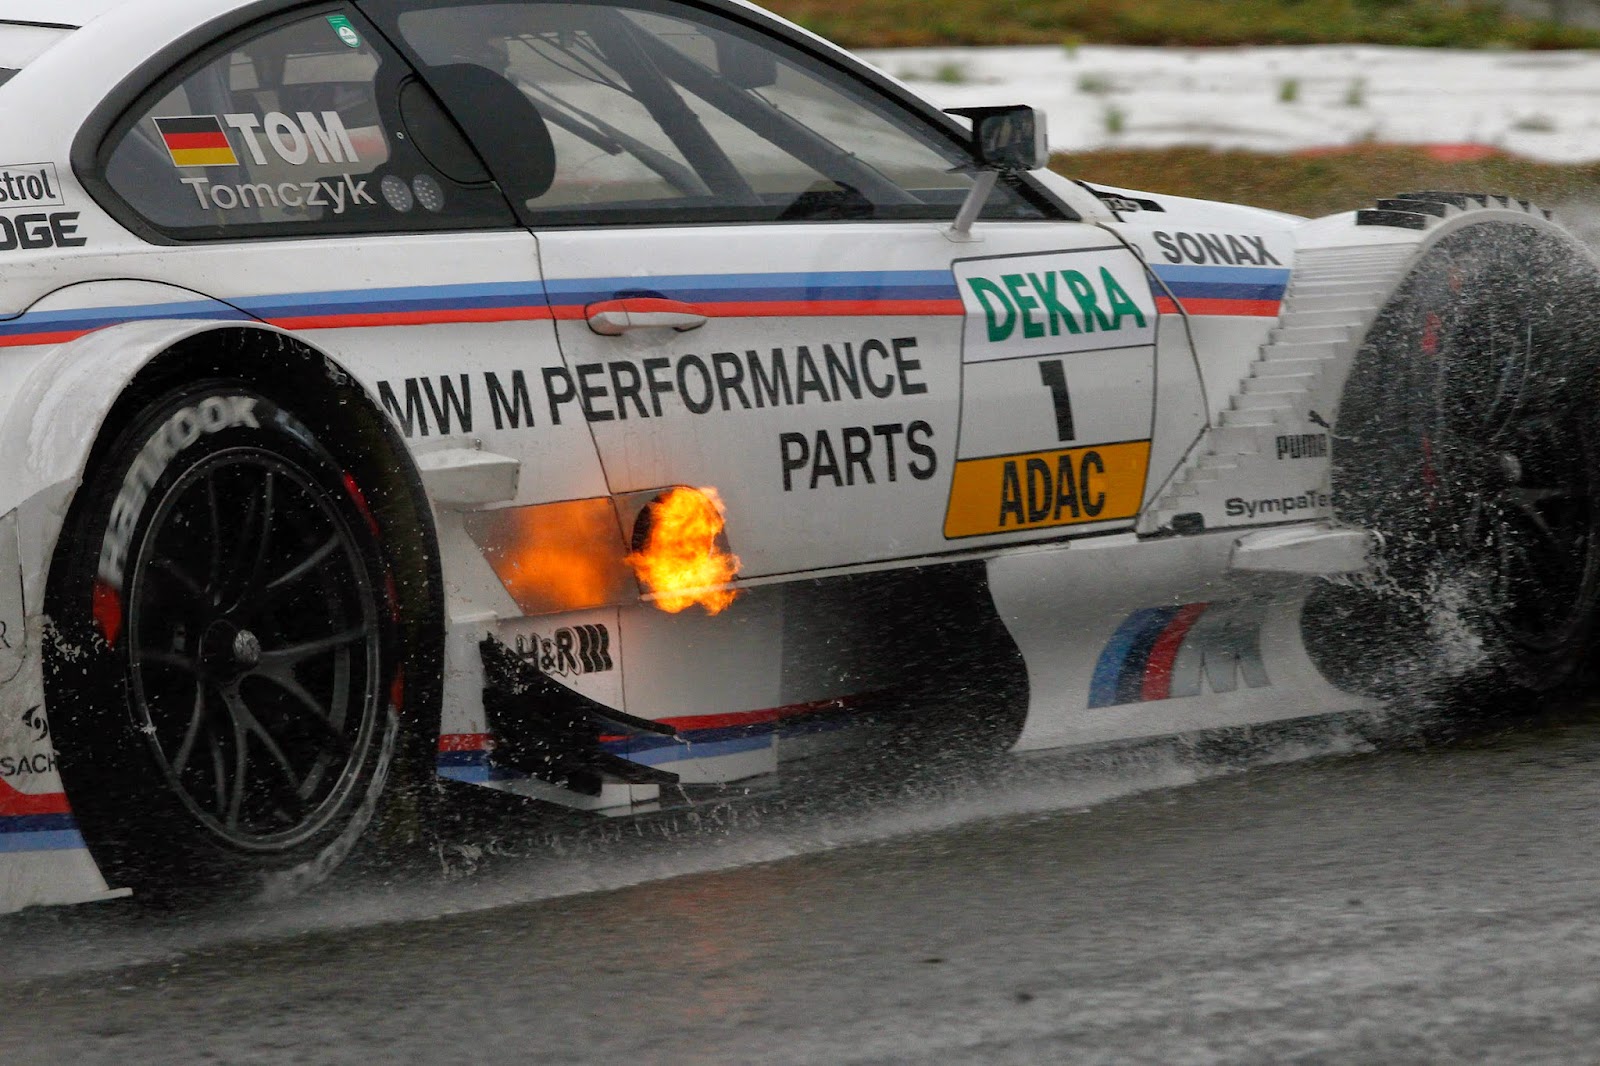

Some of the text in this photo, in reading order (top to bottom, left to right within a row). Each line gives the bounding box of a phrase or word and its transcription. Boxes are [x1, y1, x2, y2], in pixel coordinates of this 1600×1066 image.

[224, 110, 360, 167] TOM
[180, 174, 377, 214] Tomczyk
[1153, 230, 1283, 266] SONAX
[966, 266, 1148, 343] DEKRA
[483, 369, 535, 428] M
[542, 337, 928, 425] PERFORMANCE
[1038, 359, 1076, 442] 1
[780, 420, 938, 491] PARTS
[998, 451, 1106, 527] ADAC
